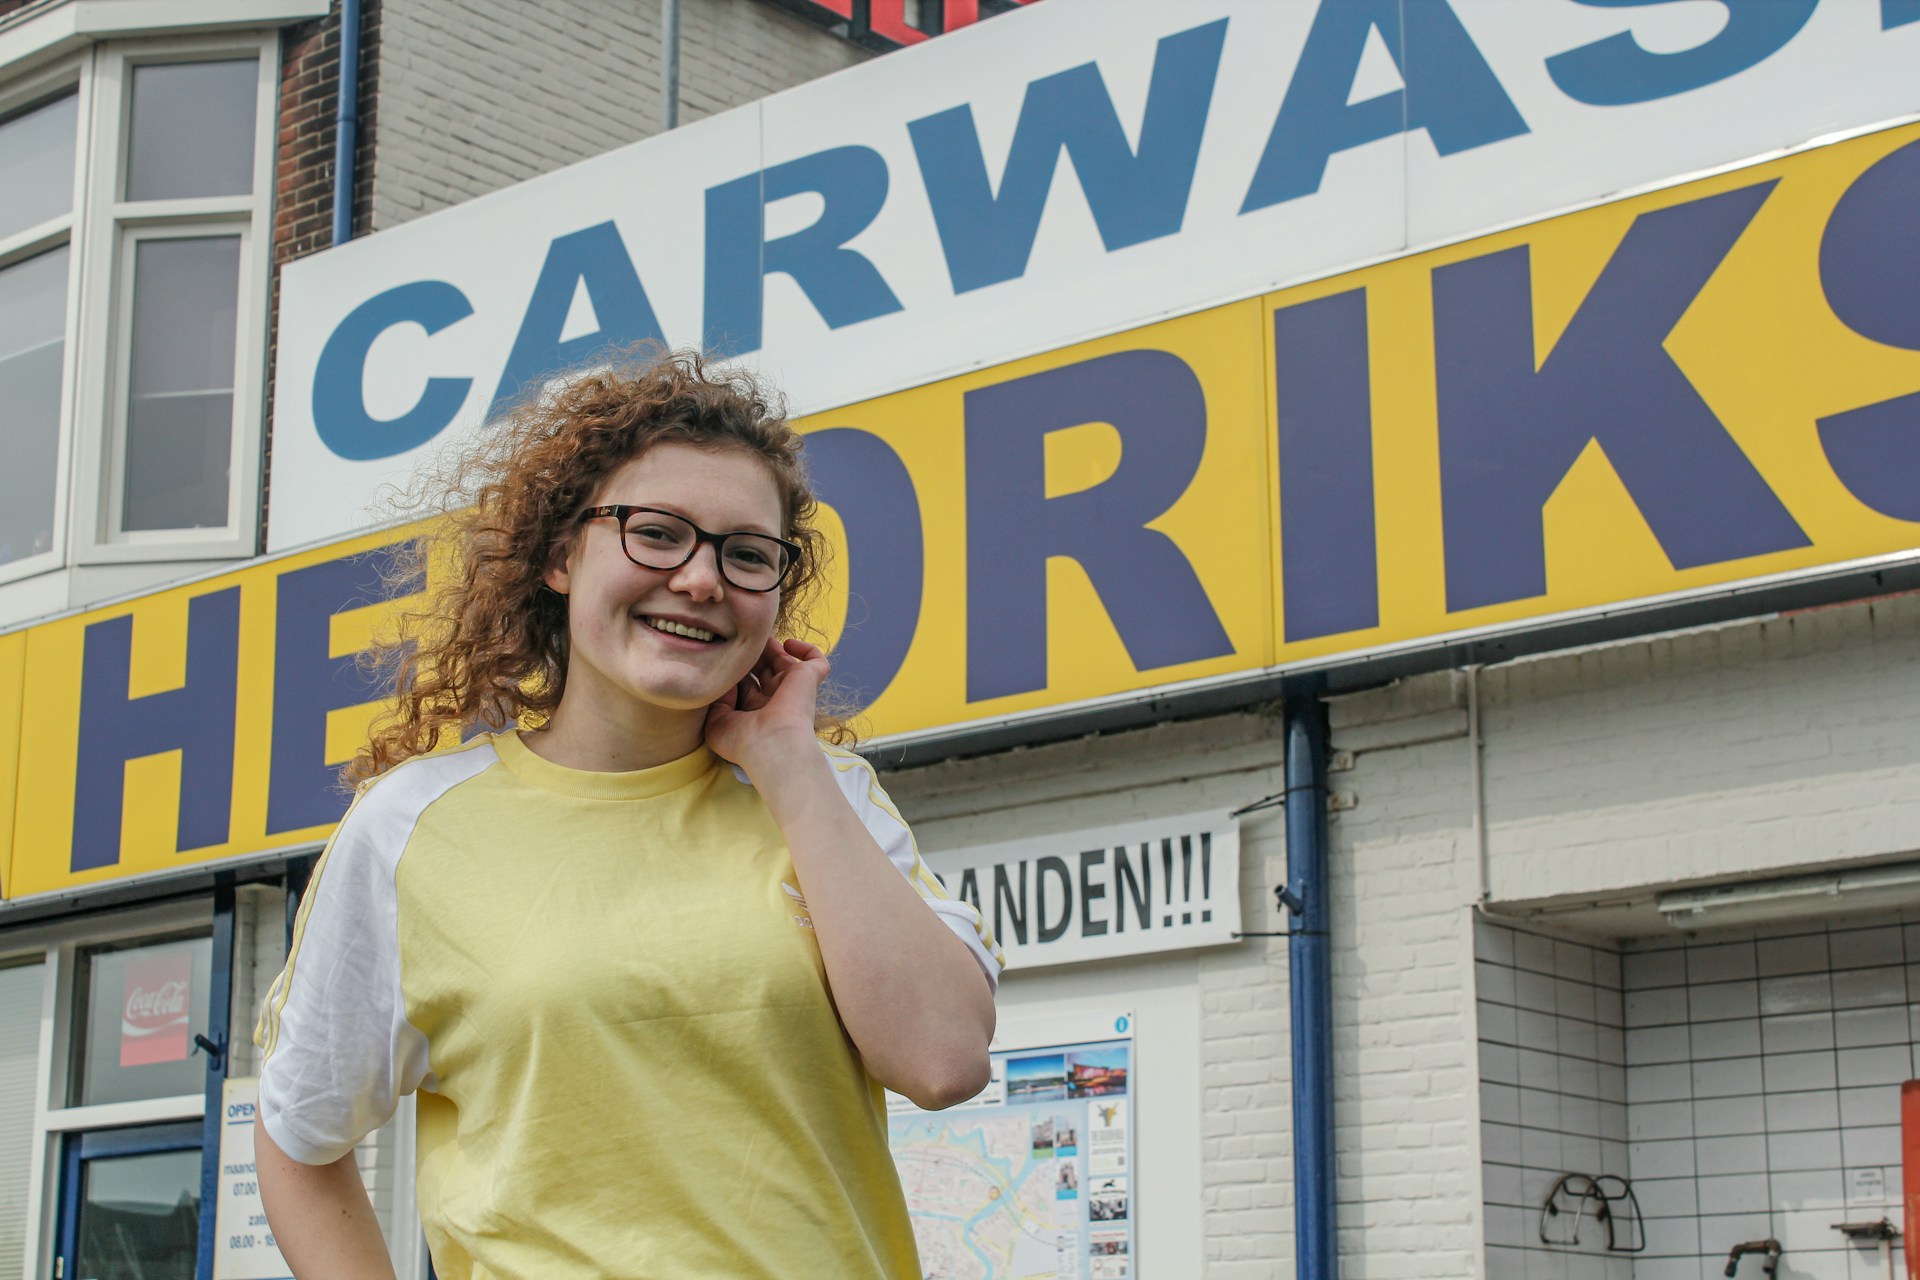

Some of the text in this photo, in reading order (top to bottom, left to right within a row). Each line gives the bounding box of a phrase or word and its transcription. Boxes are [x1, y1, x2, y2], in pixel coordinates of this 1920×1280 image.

[312, 0, 1920, 462] CARWA
[70, 137, 1920, 873] HEDRIK
[934, 832, 1211, 948] ANDEN!!!
